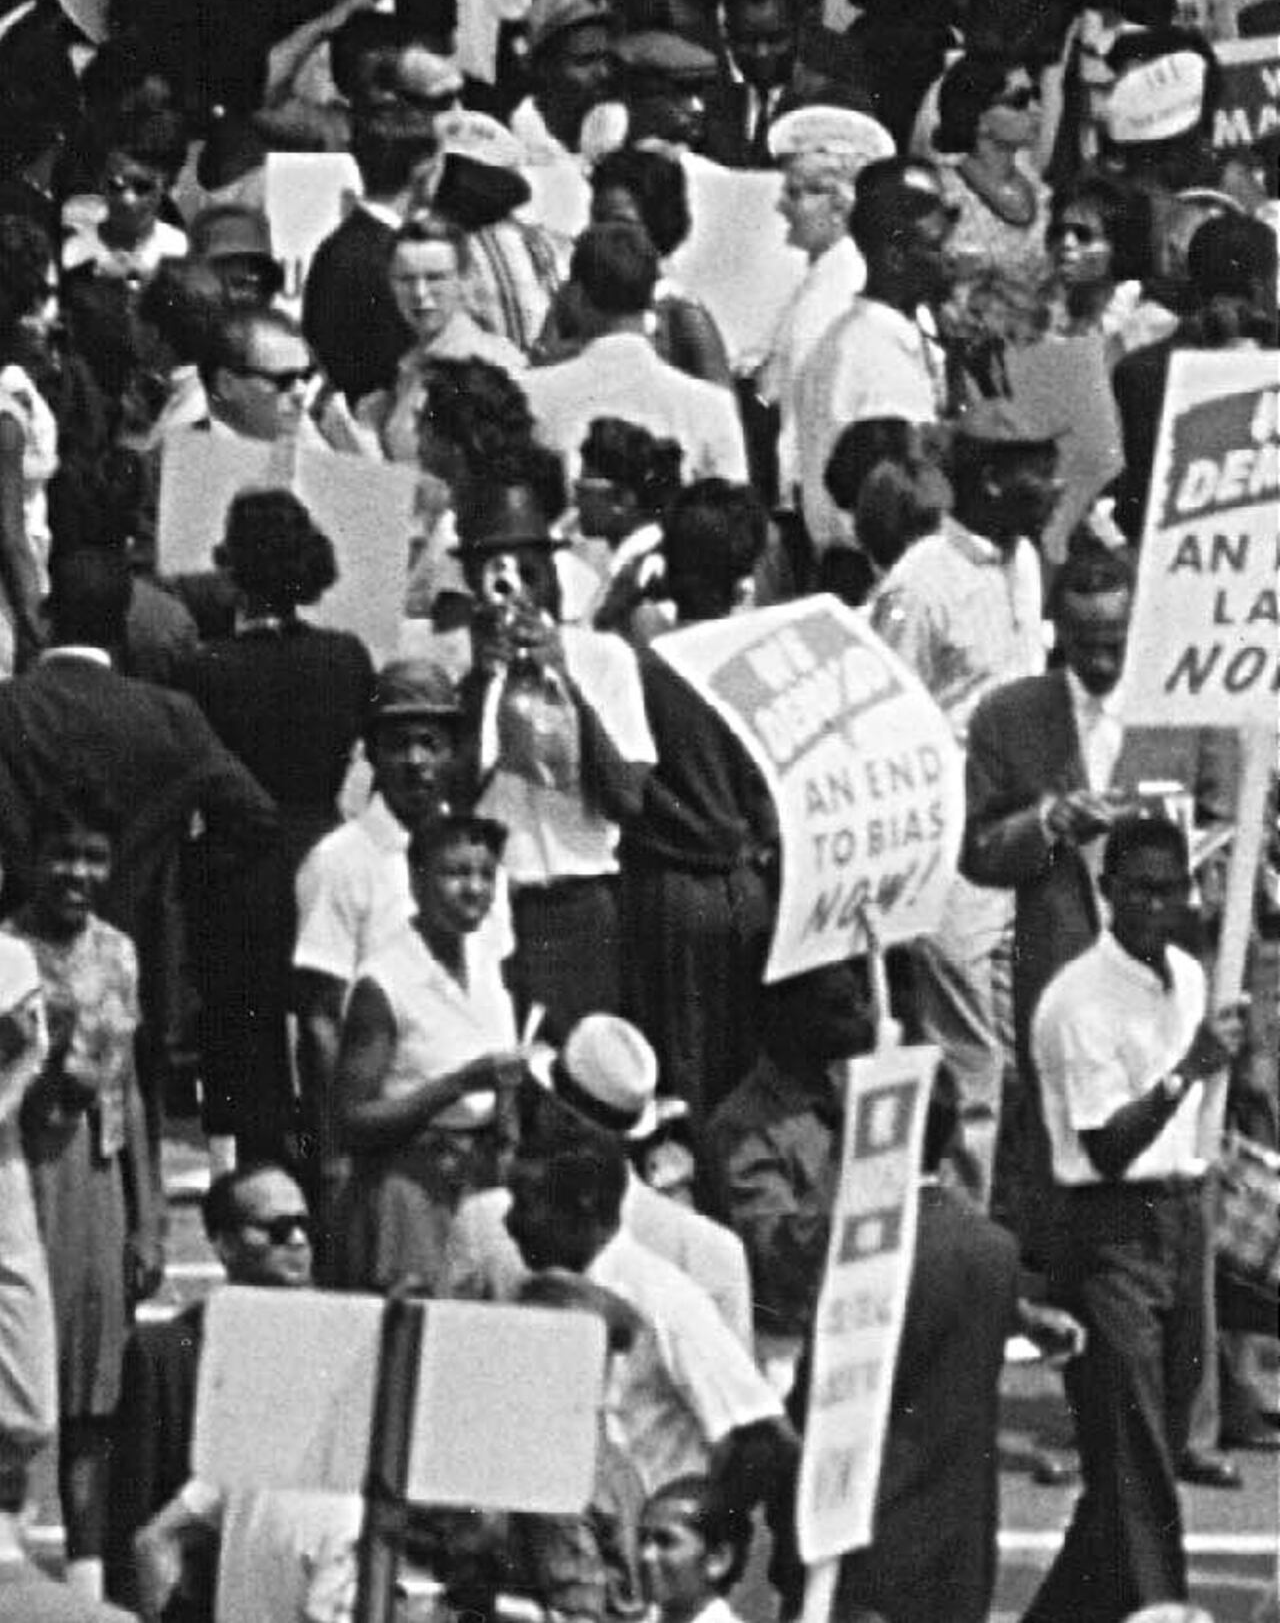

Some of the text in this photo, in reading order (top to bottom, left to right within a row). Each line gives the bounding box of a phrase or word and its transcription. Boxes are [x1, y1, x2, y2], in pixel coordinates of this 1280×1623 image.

[806, 746, 938, 816] AN END
[815, 805, 943, 864] TO BIAS
